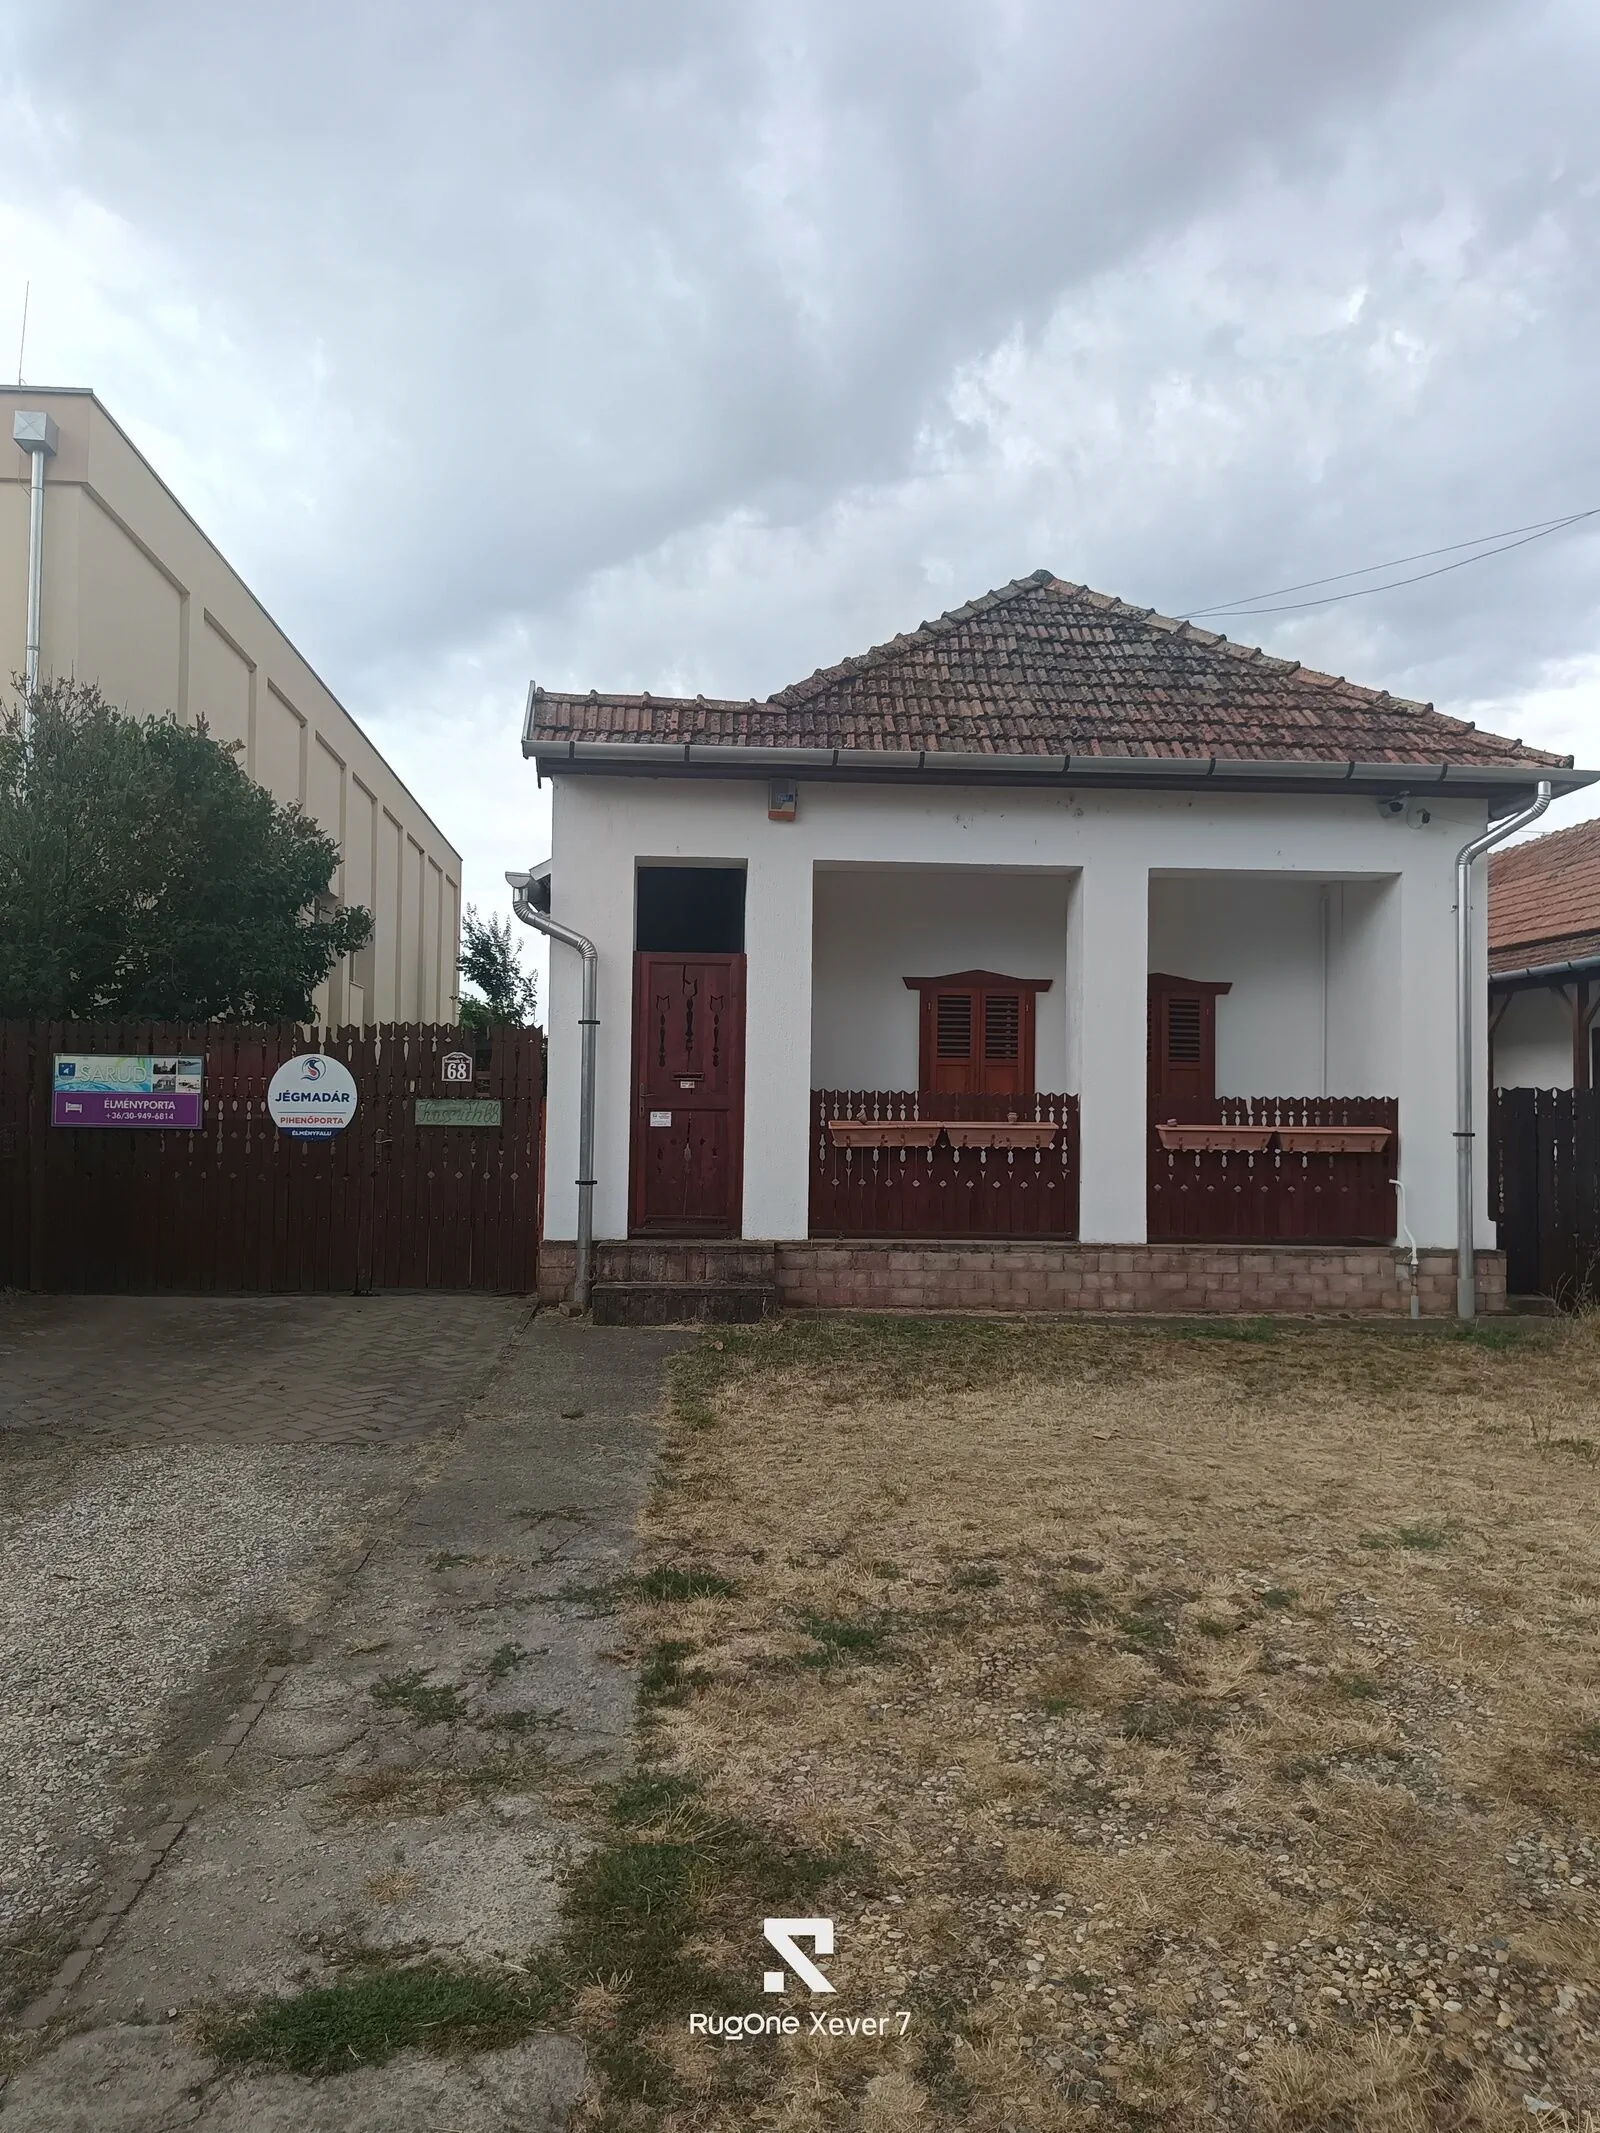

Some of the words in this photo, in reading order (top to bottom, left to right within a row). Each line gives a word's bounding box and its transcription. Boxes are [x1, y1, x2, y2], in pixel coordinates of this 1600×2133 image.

[79, 1065, 147, 1084] SARUD
[447, 1063, 467, 1079] 68
[275, 1090, 350, 1102] JÉGMADÁR
[104, 1098, 176, 1110] ÉLMÉNYPORTA
[106, 1112, 174, 1120] +36/30-949-6814
[280, 1115, 344, 1124] PIHENŐPORTA
